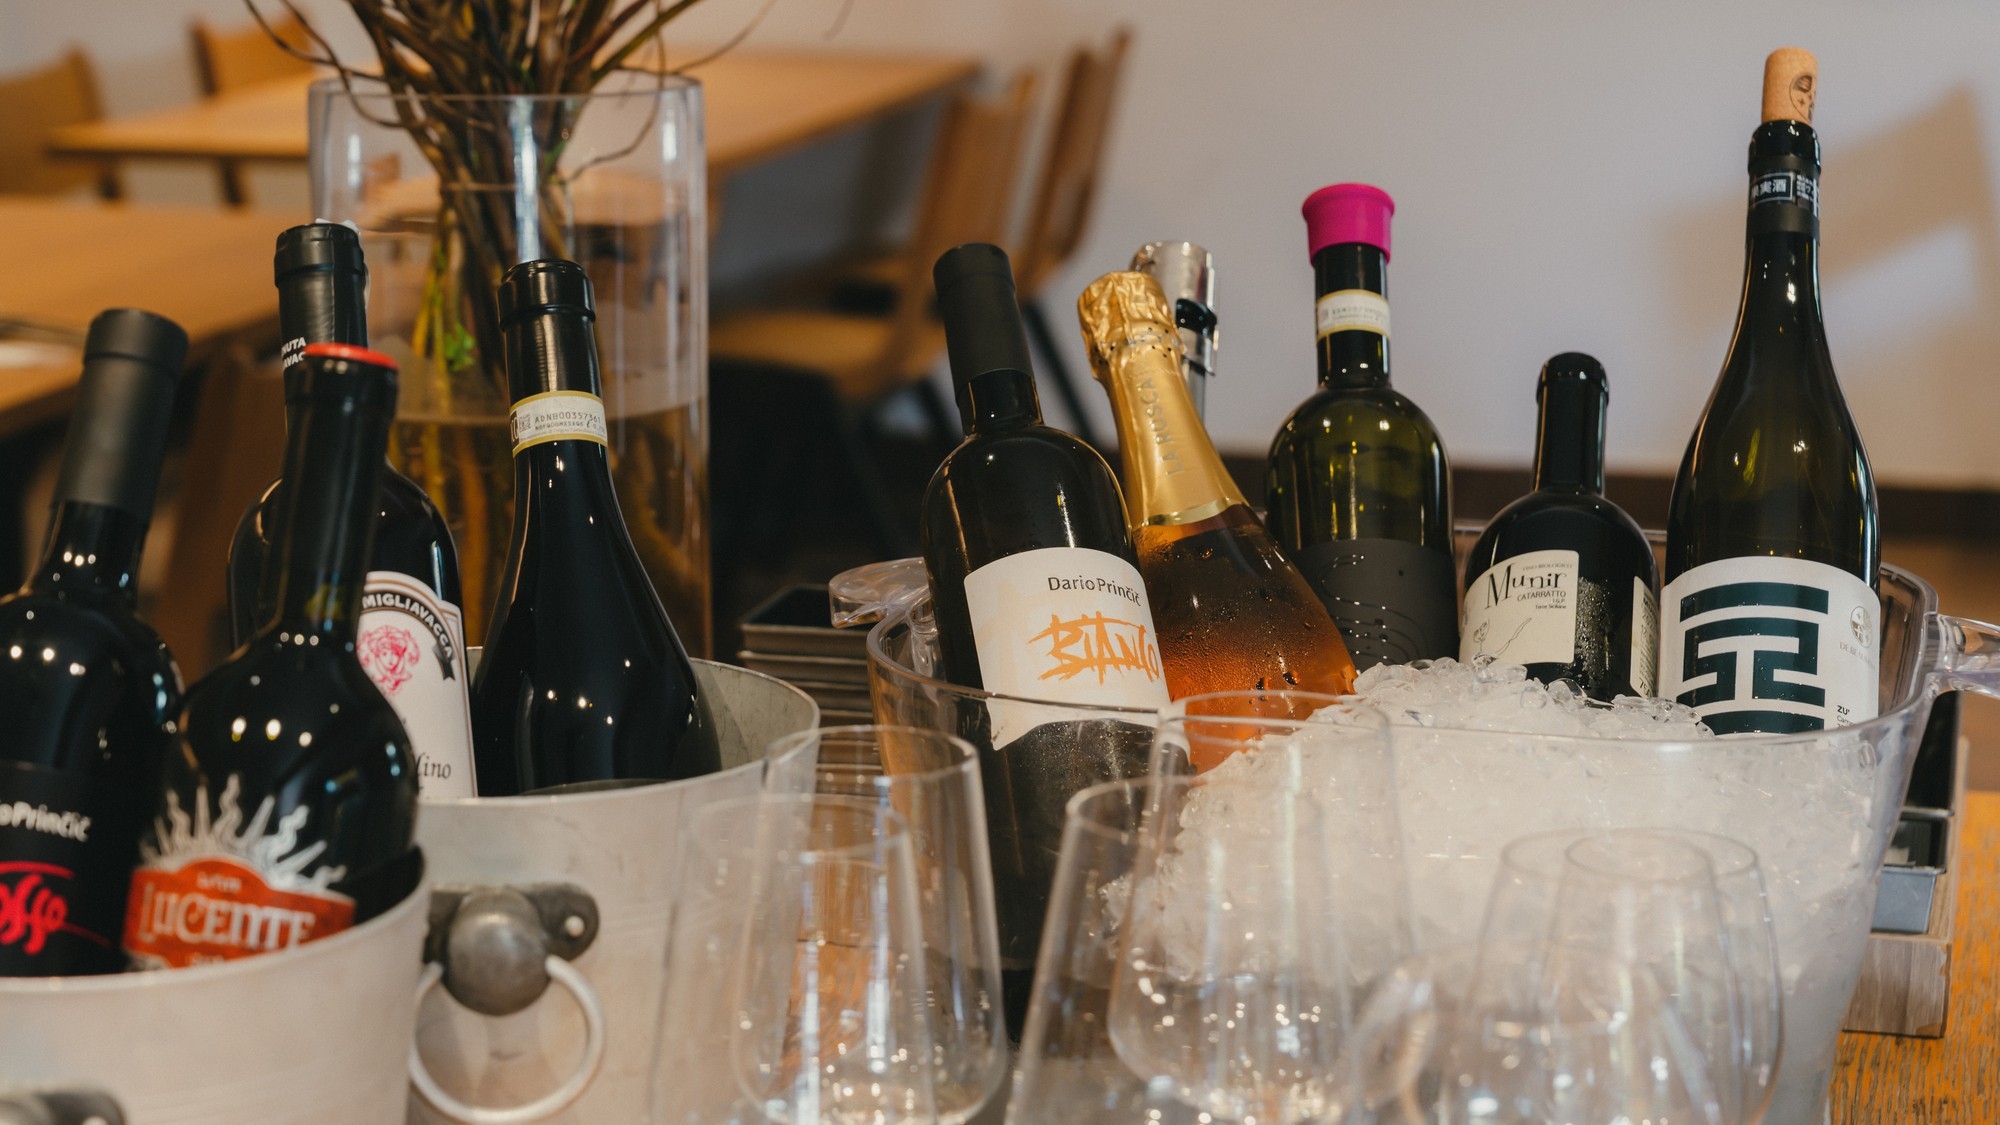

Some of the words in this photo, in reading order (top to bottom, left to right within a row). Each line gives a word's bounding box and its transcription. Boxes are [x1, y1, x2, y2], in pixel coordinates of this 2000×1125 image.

[1484, 562, 1568, 610] Munir
[1517, 590, 1567, 602] CATARRATTO
[362, 593, 454, 659] MIGLIAVACCA
[1025, 611, 1160, 685] BIANCO
